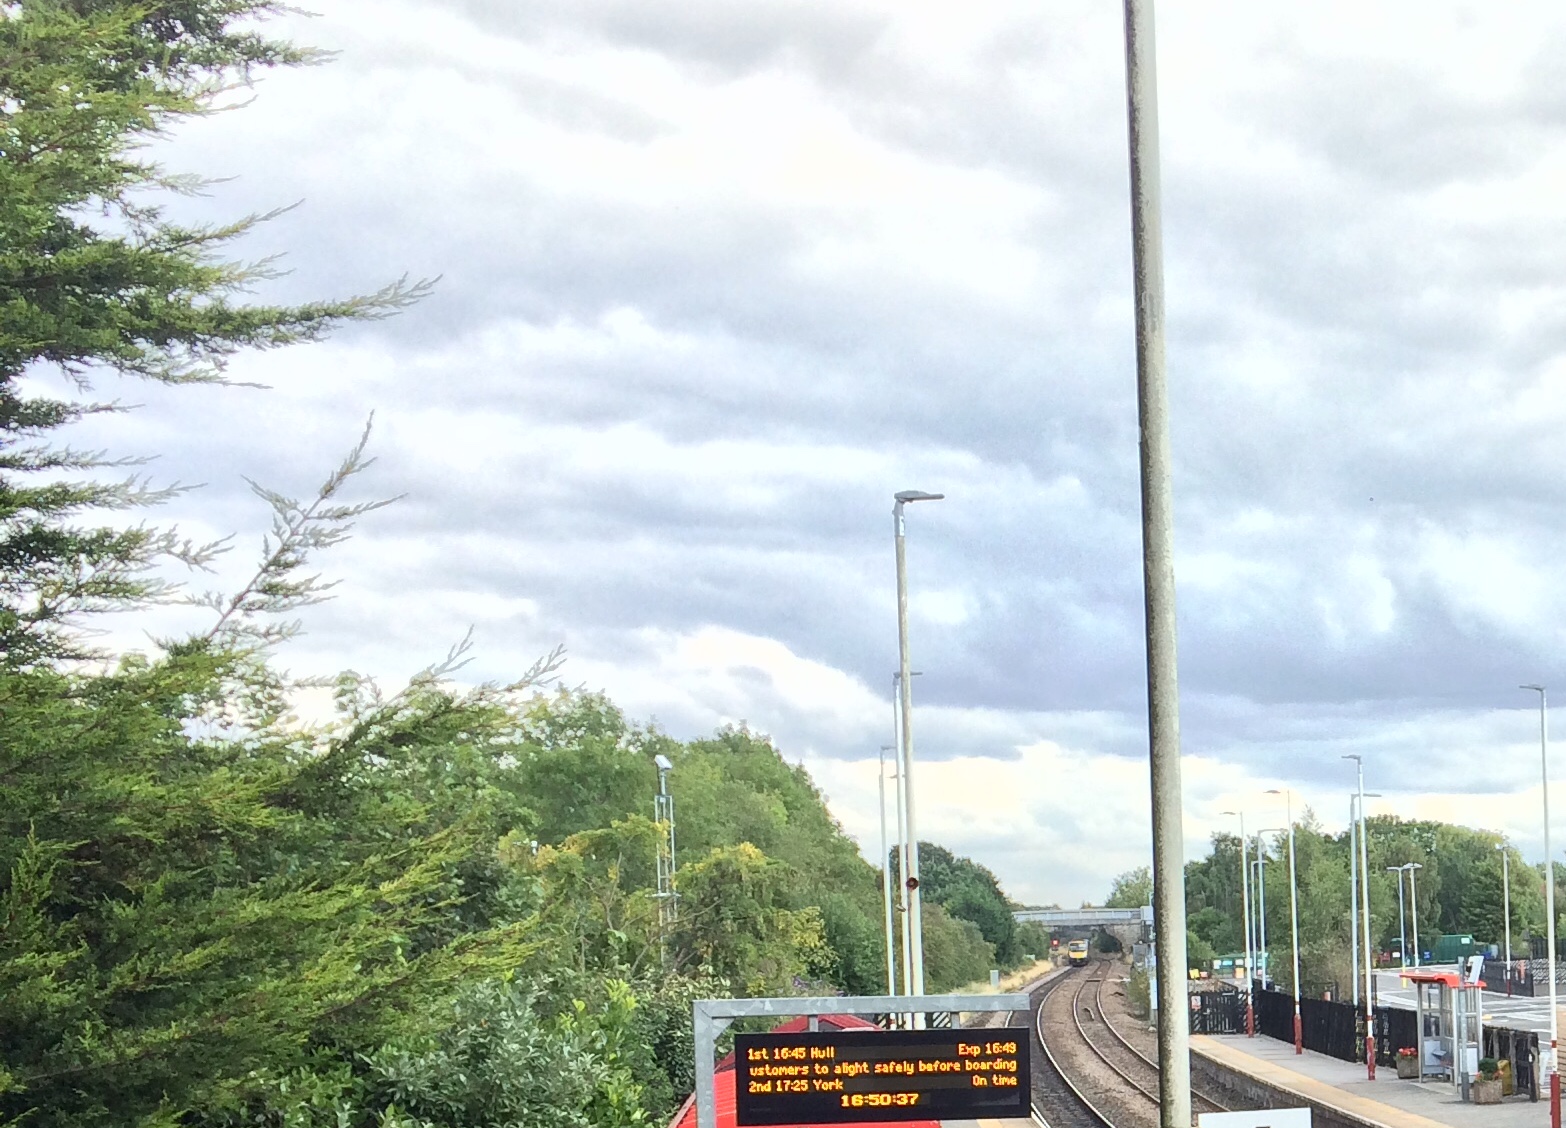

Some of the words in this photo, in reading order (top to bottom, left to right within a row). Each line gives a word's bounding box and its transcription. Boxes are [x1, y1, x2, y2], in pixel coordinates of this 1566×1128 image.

[747, 1047, 769, 1060] 1st
[773, 1047, 806, 1060] 16:45
[810, 1046, 835, 1059] Hull
[958, 1043, 981, 1057] Exp
[985, 1042, 1017, 1055] 16:49
[749, 1063, 809, 1076] ustomers
[814, 1063, 829, 1074] to
[834, 1061, 870, 1077] alight
[874, 1060, 914, 1075] safely
[918, 1060, 961, 1072] before
[964, 1058, 1017, 1072] boarding
[748, 1080, 772, 1093] 2nd
[775, 1080, 809, 1092] 17:25
[812, 1078, 844, 1091] York
[972, 1074, 988, 1086] On
[992, 1074, 1017, 1086] time
[840, 1093, 919, 1107] 16:50:37
